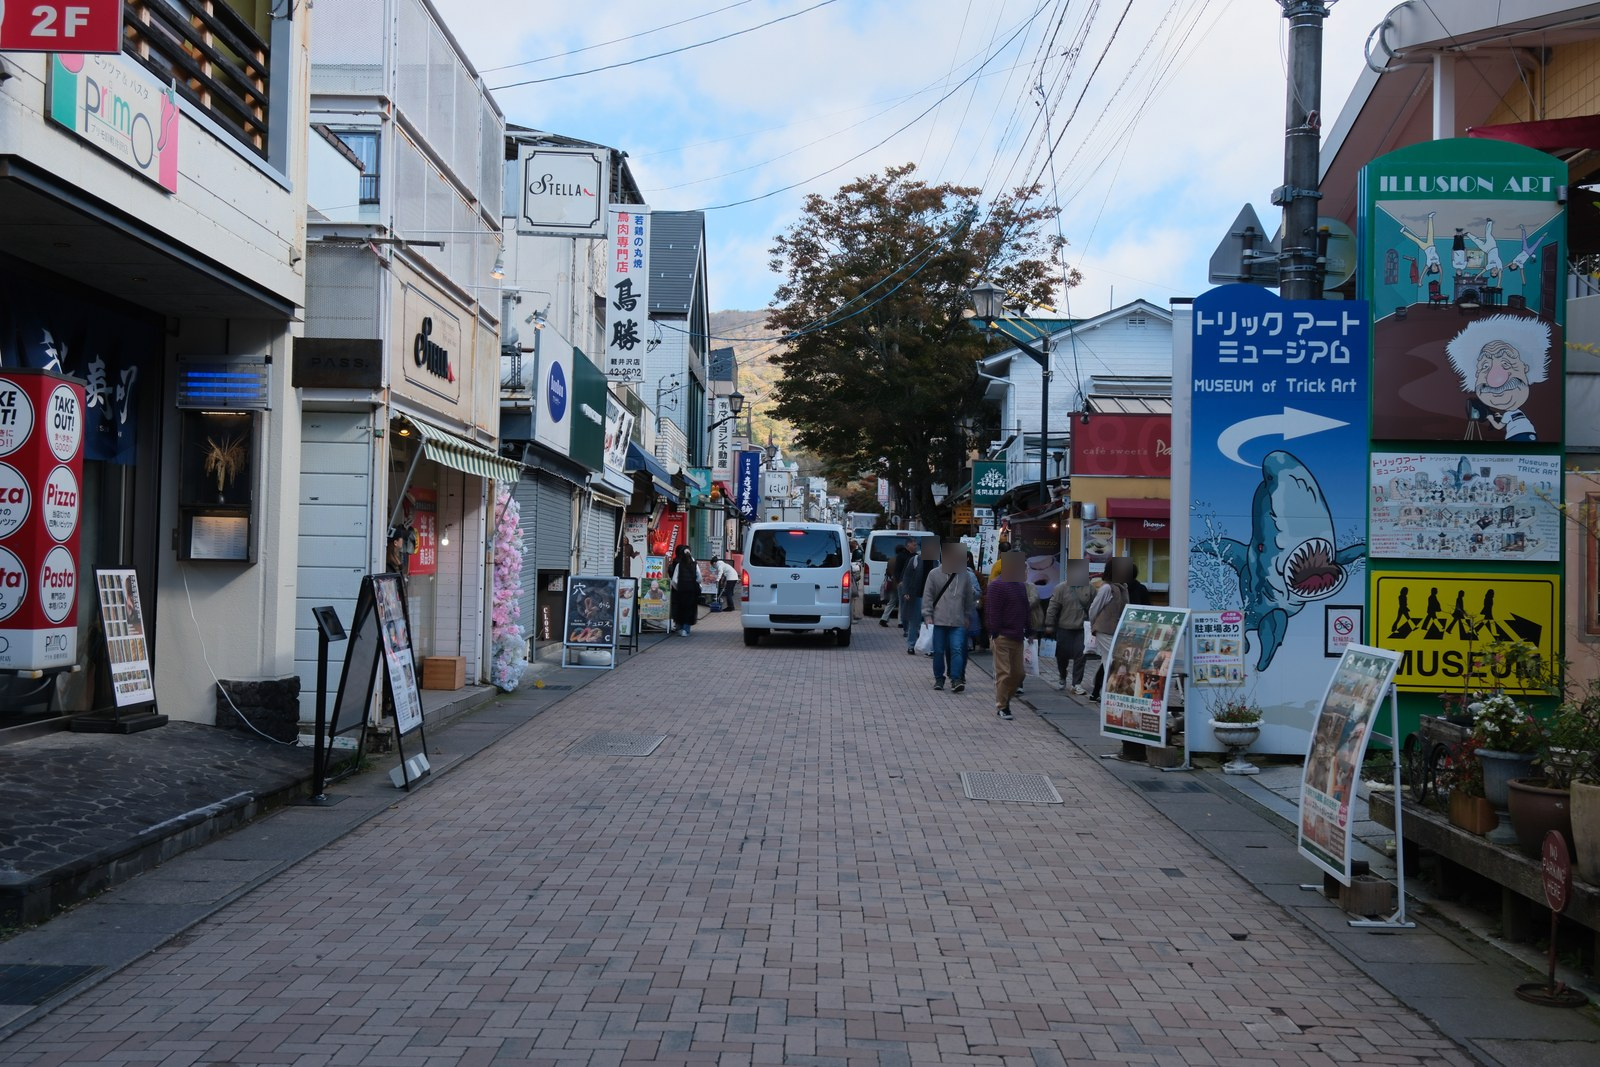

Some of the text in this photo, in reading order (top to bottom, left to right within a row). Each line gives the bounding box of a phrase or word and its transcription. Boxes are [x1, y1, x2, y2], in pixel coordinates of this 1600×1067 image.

[30, 5, 90, 37] 2F
[529, 173, 582, 196] STELLA
[1380, 175, 1555, 193] ILLUSION ART
[1219, 339, 1350, 364] ミュージアム
[610, 358, 640, 366] 軽井沢店
[1194, 378, 1357, 392] MUSEUM of Trick Art
[54, 395, 75, 415] TAKE
[54, 413, 75, 432] OUT!
[1517, 465, 1559, 476] TRICK ART
[1518, 457, 1549, 467] Museum
[47, 483, 76, 507] Pizza
[43, 566, 74, 588] Pasta
[572, 582, 586, 595] 穴
[1195, 624, 1239, 633] 駐車場あり
